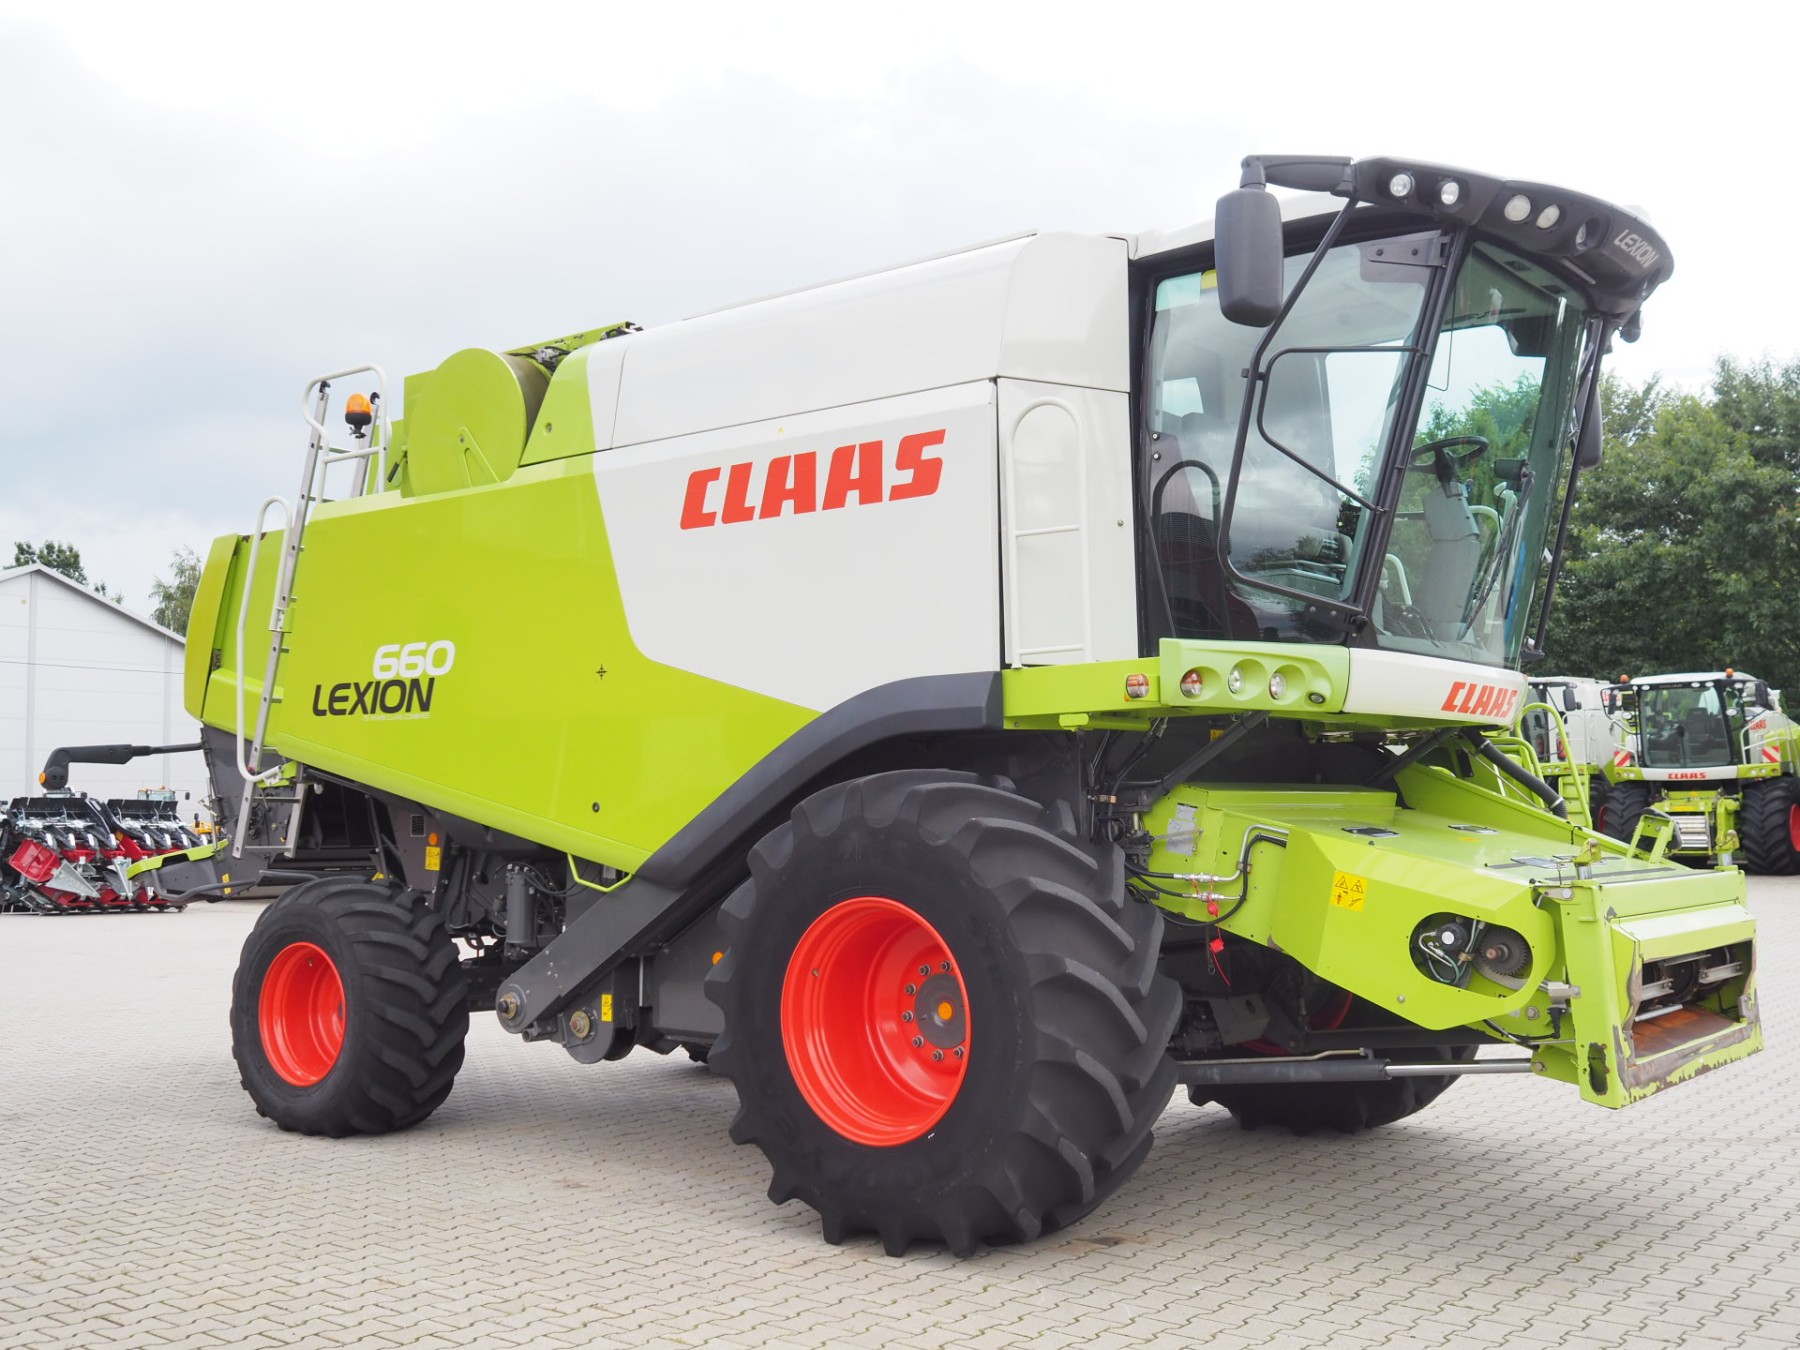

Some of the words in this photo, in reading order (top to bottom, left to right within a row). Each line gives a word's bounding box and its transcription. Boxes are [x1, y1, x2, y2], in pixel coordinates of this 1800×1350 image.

[1613, 229, 1659, 268] LEXION
[680, 429, 946, 530] CLAAS
[373, 640, 455, 680] 660
[312, 677, 435, 717] LEXION
[1441, 681, 1518, 718] CLAAS
[1667, 772, 1707, 780] CLAAS
